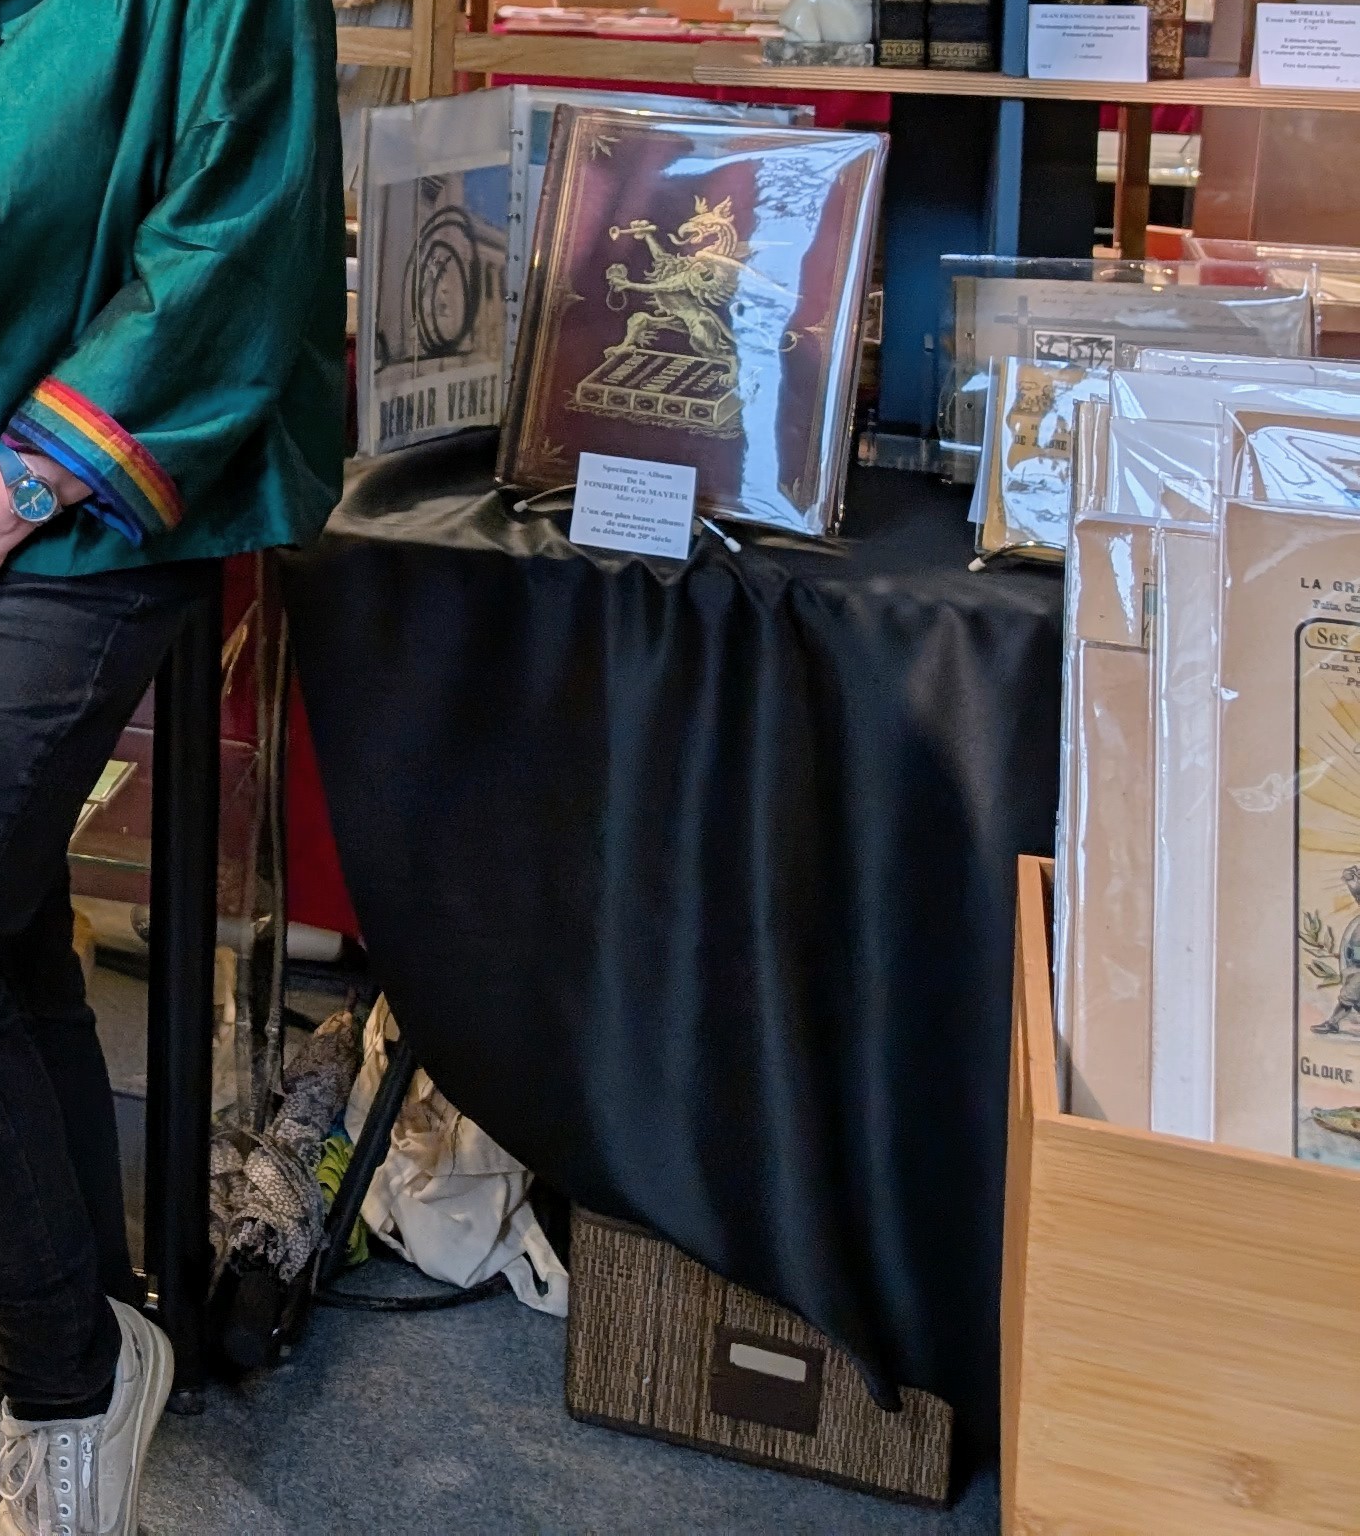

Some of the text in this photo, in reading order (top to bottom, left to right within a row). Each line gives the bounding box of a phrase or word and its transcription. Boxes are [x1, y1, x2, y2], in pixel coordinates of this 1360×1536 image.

[1301, 577, 1321, 590] LA
[1317, 627, 1349, 647] Ses
[1301, 1056, 1352, 1083] GLOIRE
